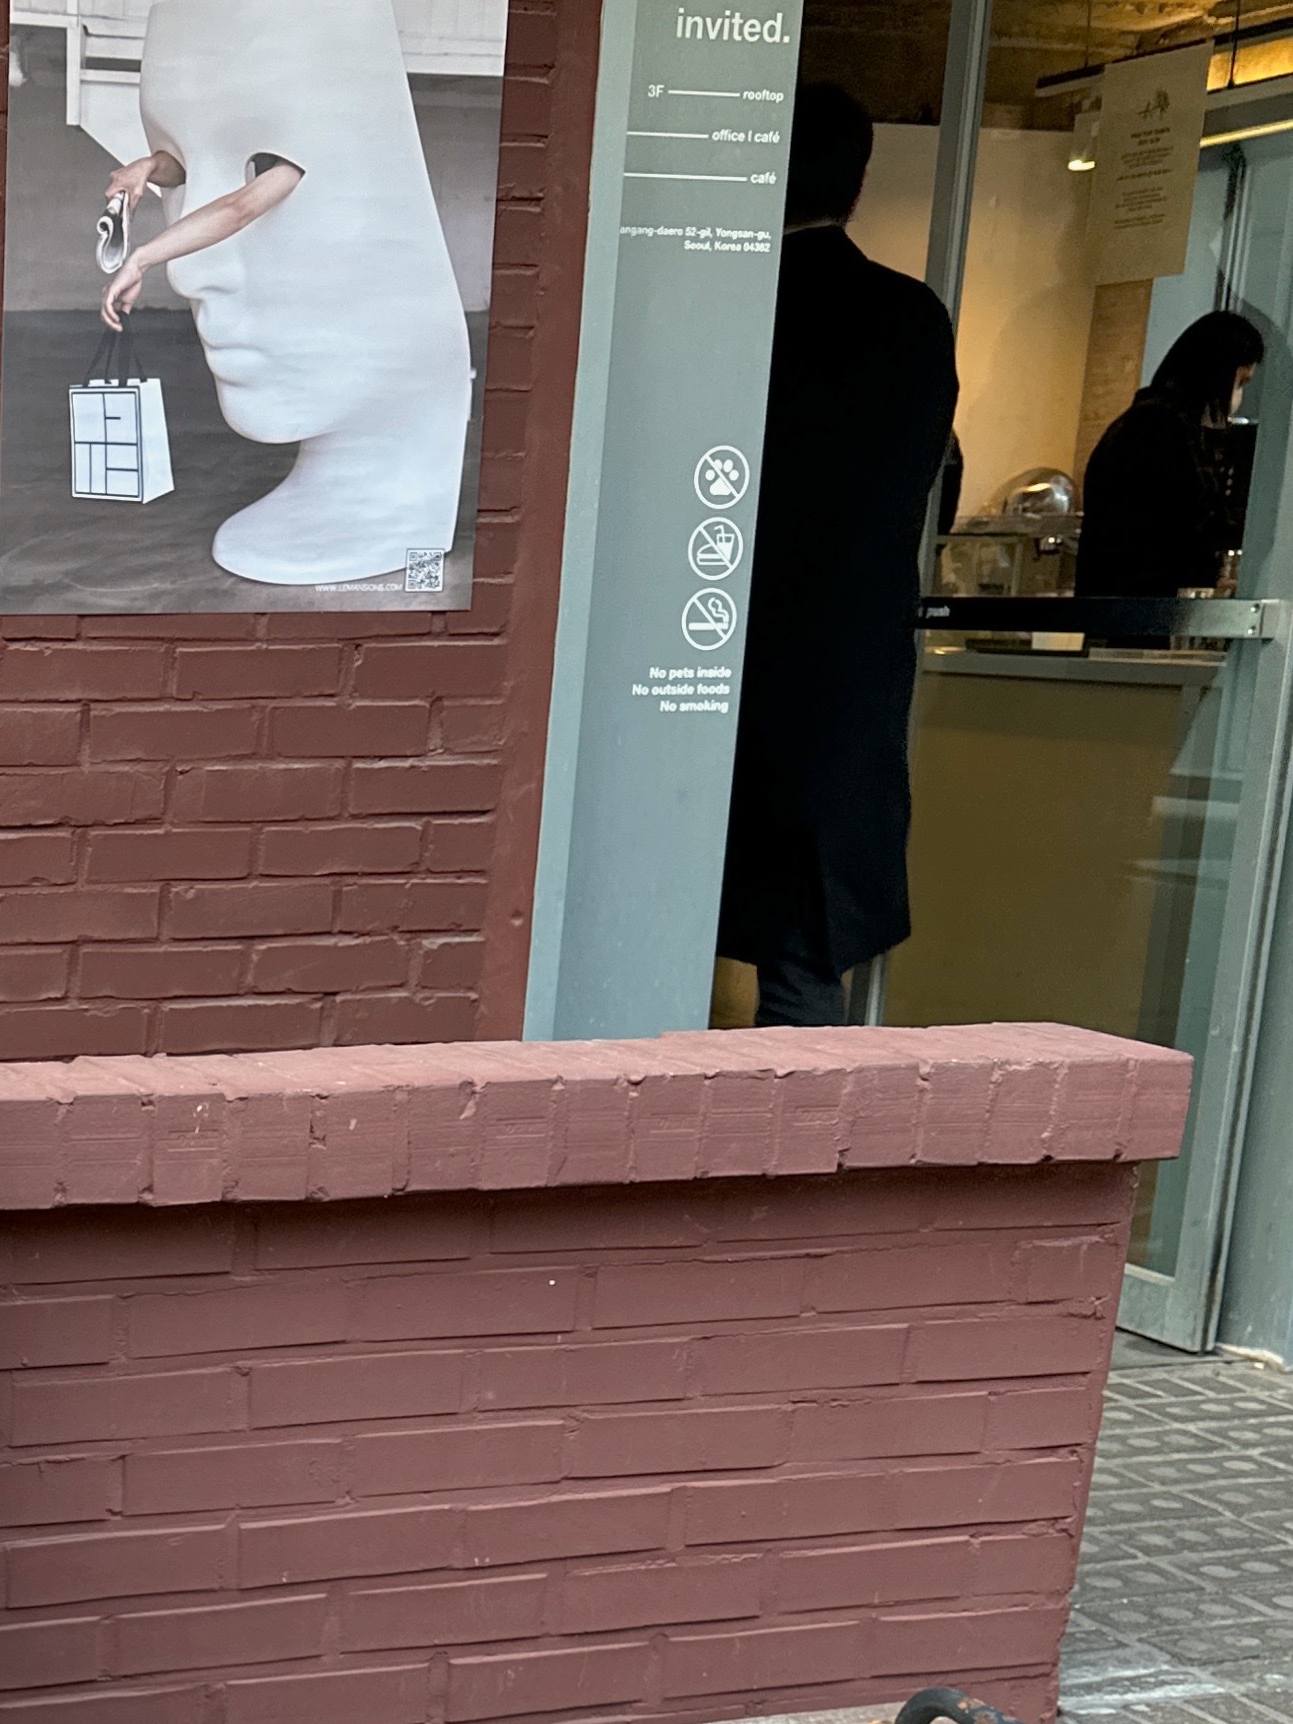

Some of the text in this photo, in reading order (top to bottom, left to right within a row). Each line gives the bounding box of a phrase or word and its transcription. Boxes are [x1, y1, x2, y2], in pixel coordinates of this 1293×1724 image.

[675, 7, 791, 43] invited.
[647, 84, 784, 104] 3F rooftop
[711, 129, 745, 143] office
[754, 130, 780, 144] café
[750, 171, 777, 185] café
[619, 225, 684, 237] angang-daero
[714, 240, 742, 252] Korea
[649, 666, 732, 681] No pets inside
[631, 683, 730, 696] No outside foods
[659, 699, 729, 714] No smoking
